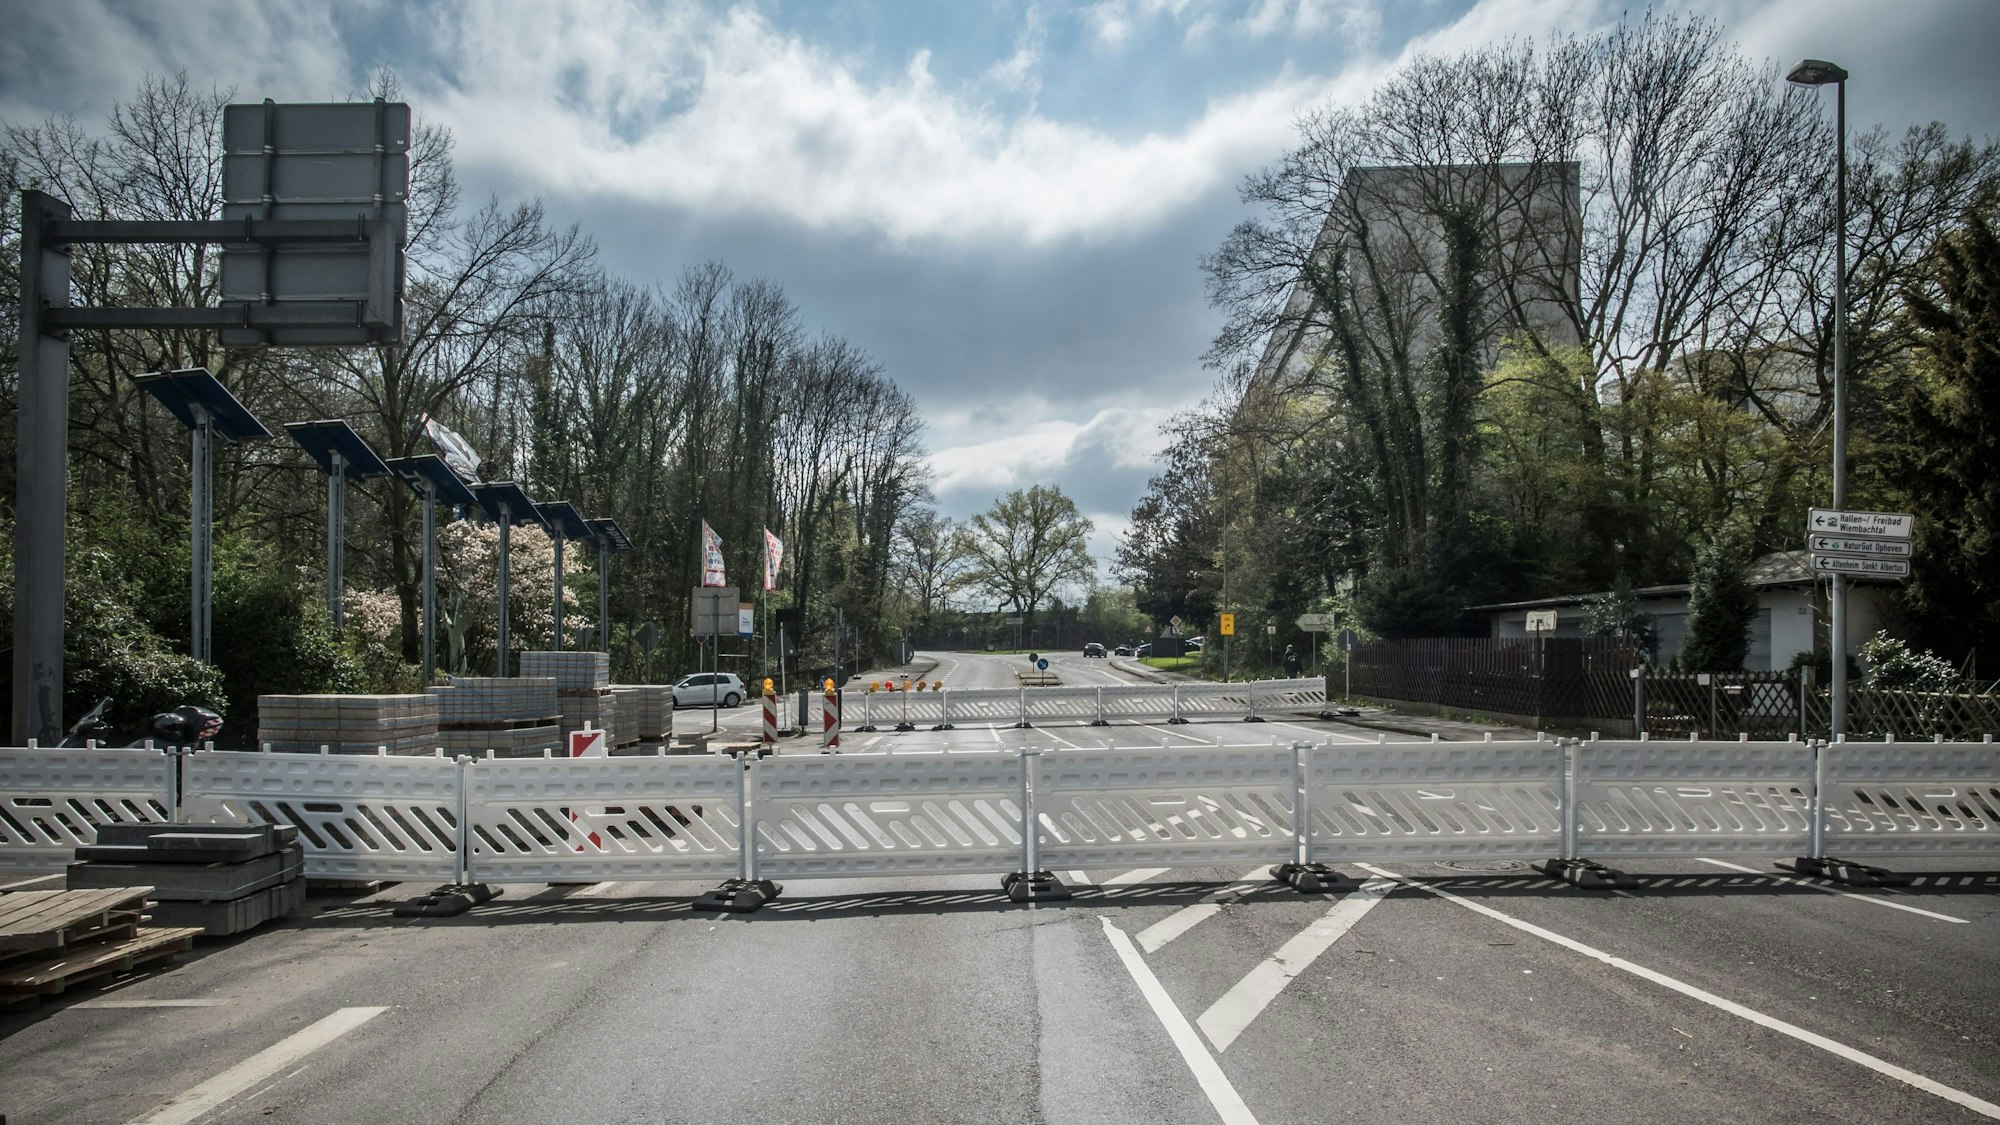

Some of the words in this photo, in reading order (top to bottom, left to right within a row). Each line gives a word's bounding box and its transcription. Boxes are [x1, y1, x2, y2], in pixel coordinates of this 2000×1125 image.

[1873, 516, 1902, 525] Freibad
[1840, 523, 1886, 534] Wiembachtal
[1875, 543, 1902, 553] Ophoven
[1832, 560, 1860, 569] Altenheim
[1861, 561, 1878, 570] Sankt
[1880, 562, 1903, 571] Albertus
